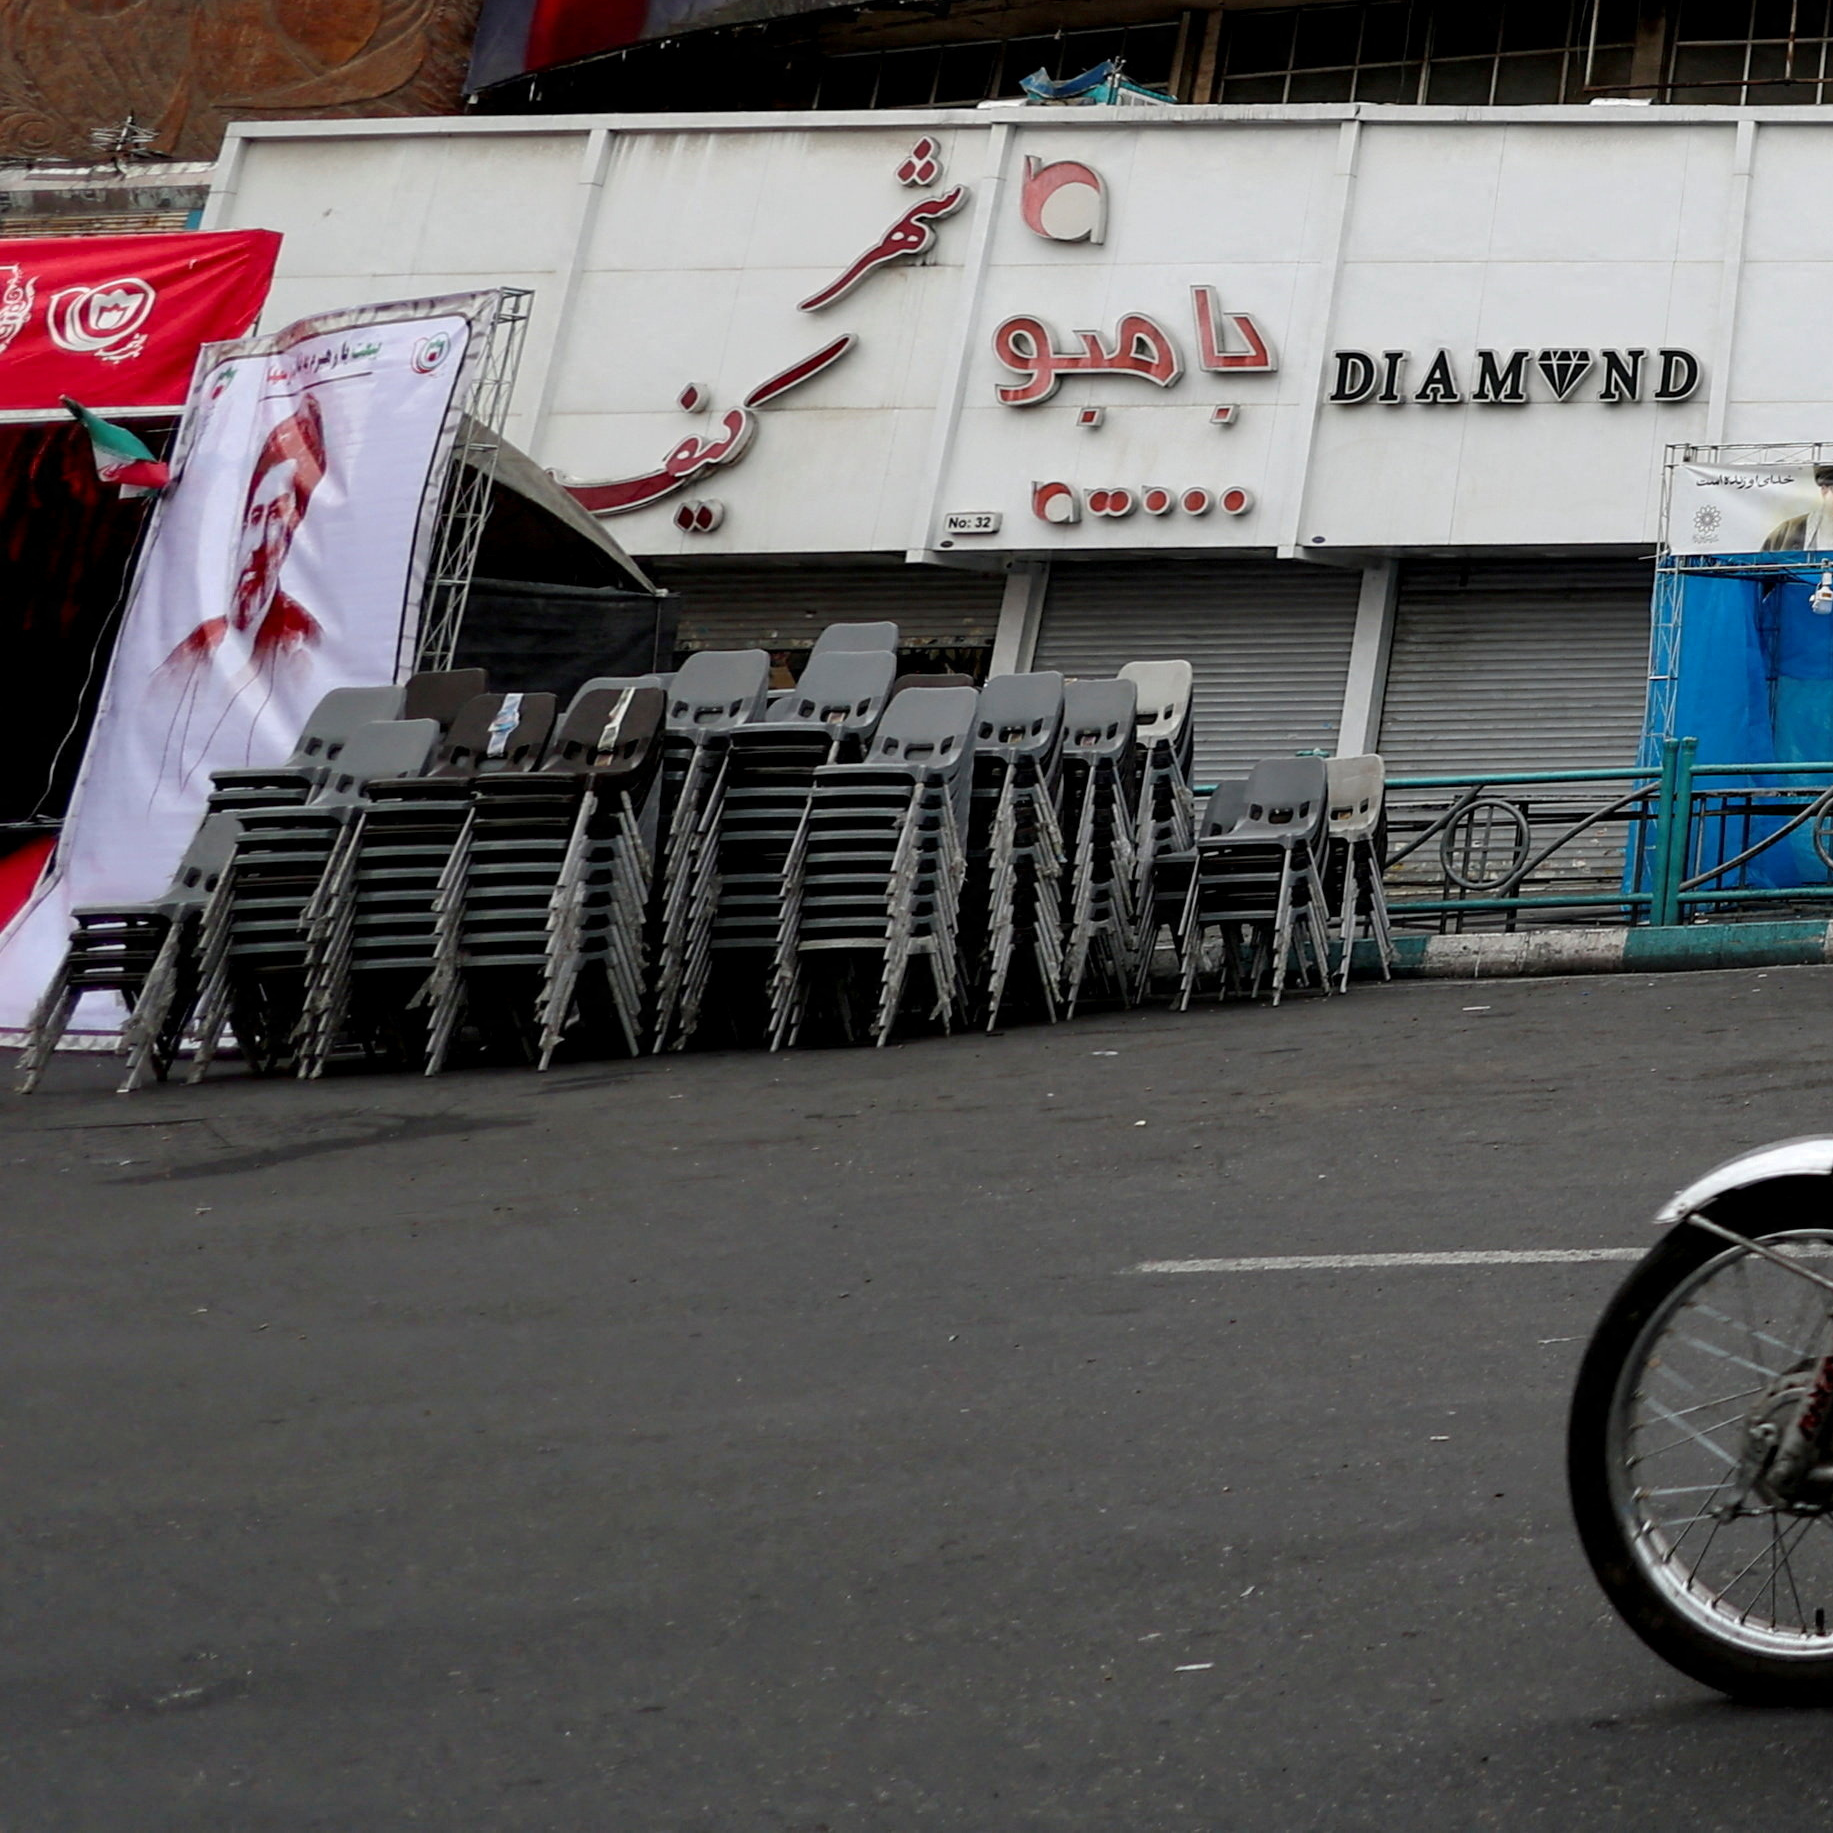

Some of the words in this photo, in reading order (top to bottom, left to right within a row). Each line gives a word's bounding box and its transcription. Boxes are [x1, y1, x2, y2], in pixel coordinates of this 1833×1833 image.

[798, 134, 970, 314] شهر
[947, 515, 972, 530] No:
[974, 515, 992, 529] 32
